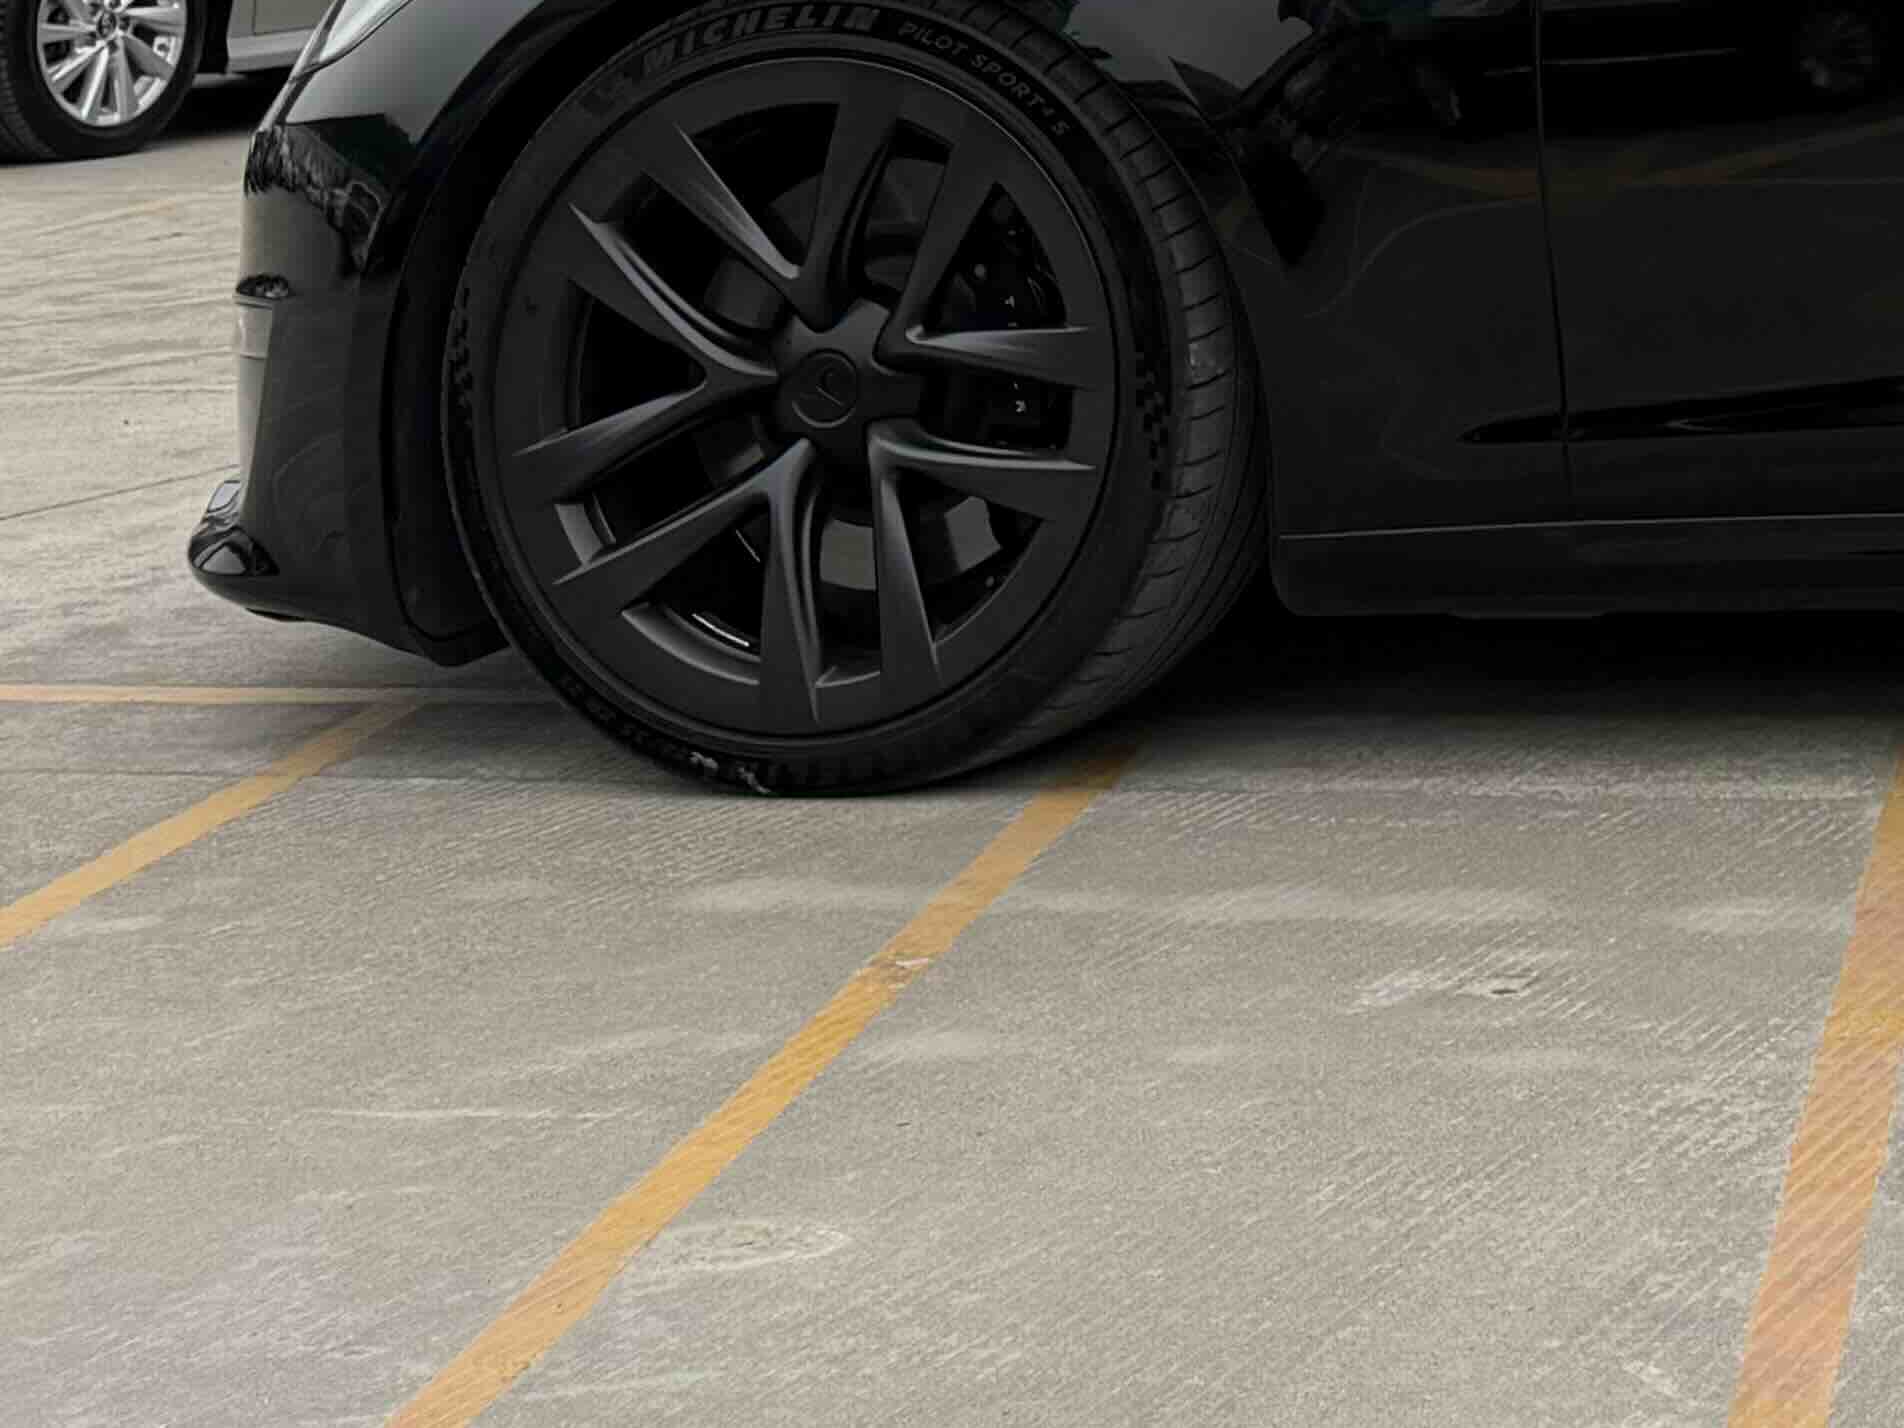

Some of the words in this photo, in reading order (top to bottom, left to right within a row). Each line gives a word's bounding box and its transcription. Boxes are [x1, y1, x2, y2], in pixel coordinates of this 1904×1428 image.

[641, 4, 881, 78] MICHELIN
[897, 20, 969, 56] PILOT
[971, 53, 1046, 107] SPORT
